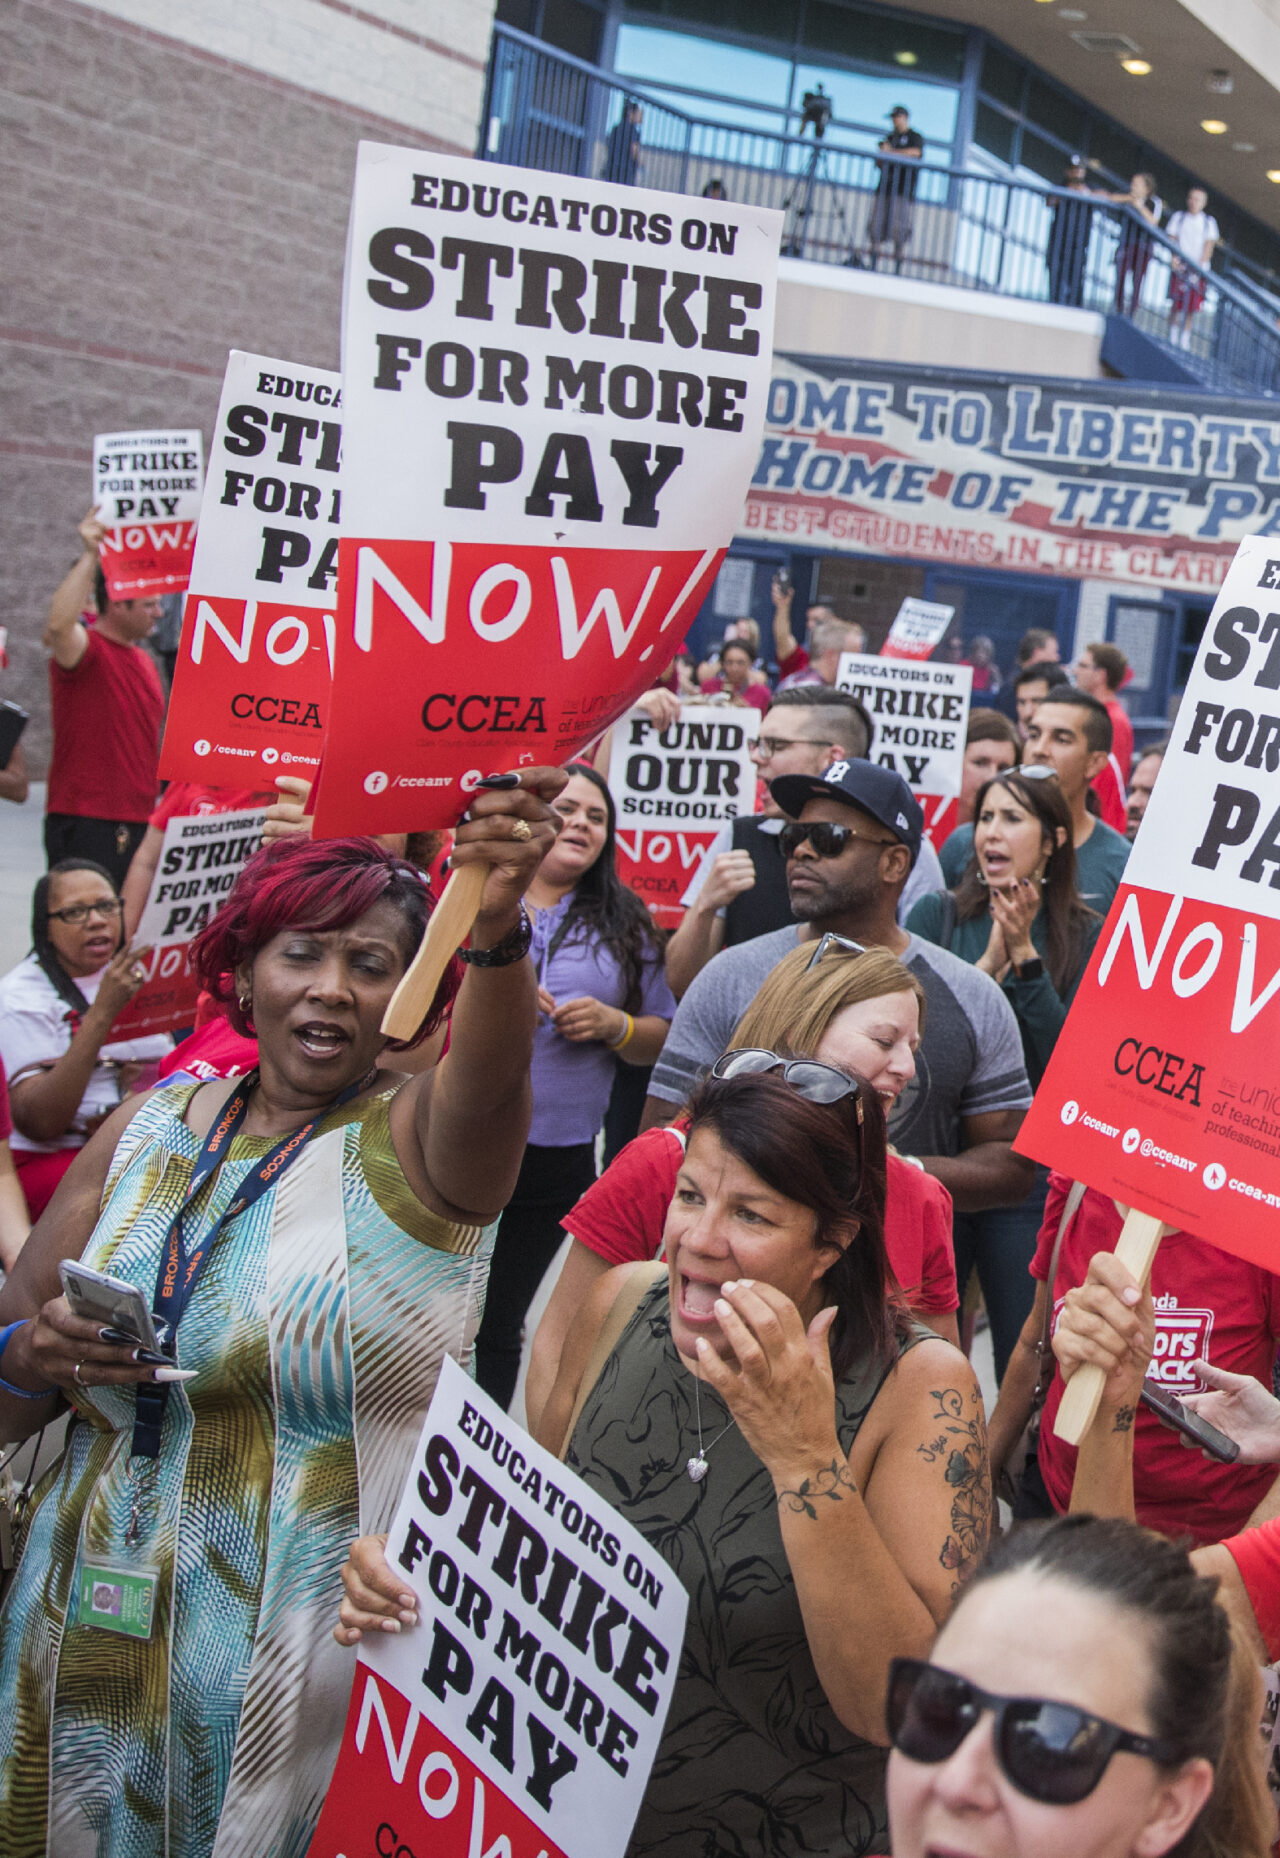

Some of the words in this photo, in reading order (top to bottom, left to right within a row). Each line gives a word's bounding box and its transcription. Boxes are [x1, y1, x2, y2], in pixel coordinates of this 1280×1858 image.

[411, 174, 672, 245] EDUCATORS
[680, 219, 738, 256] ON
[366, 226, 762, 357] STRIKE
[373, 334, 530, 406] FOR
[544, 355, 747, 432] MORE
[908, 387, 992, 447] TO
[99, 452, 197, 472] STRIKE
[100, 479, 134, 493] FOR
[140, 477, 196, 491] MORE
[443, 421, 683, 529] PAY
[752, 439, 938, 503] HOME
[952, 469, 1035, 515] OF
[1054, 481, 1189, 535] THE
[115, 498, 179, 518] PAY
[220, 470, 321, 521] FOR
[745, 502, 826, 535] BEST
[830, 510, 996, 562] STUDENTS
[1007, 534, 1043, 562] IN
[1055, 540, 1114, 573] THE
[353, 541, 720, 662] NOW!
[934, 673, 954, 684] ON
[231, 693, 322, 729] CCEA
[421, 694, 548, 733] CCEA
[630, 719, 744, 751] FUND
[881, 725, 956, 750] MORE
[391, 775, 453, 788] /cceanv
[626, 754, 740, 797] OUR
[182, 817, 254, 837] EDUCATORS
[623, 798, 738, 820] SCHOOLS
[155, 880, 201, 903] FOR
[630, 876, 678, 893] CCEA
[1113, 1038, 1206, 1107] CCEA
[208, 1097, 244, 1153] BRONCOS
[1211, 1100, 1228, 1116] of
[260, 1124, 313, 1181] BRONCOS
[1078, 1111, 1120, 1140] /cceanv
[1140, 1139, 1197, 1173] @cceanv
[458, 1401, 621, 1567] EDUCATORS
[623, 1550, 664, 1610] ON
[417, 1434, 670, 1717] STRIKE
[398, 1518, 492, 1642] FOR
[494, 1609, 639, 1778] MORE
[422, 1617, 578, 1814] PAY
